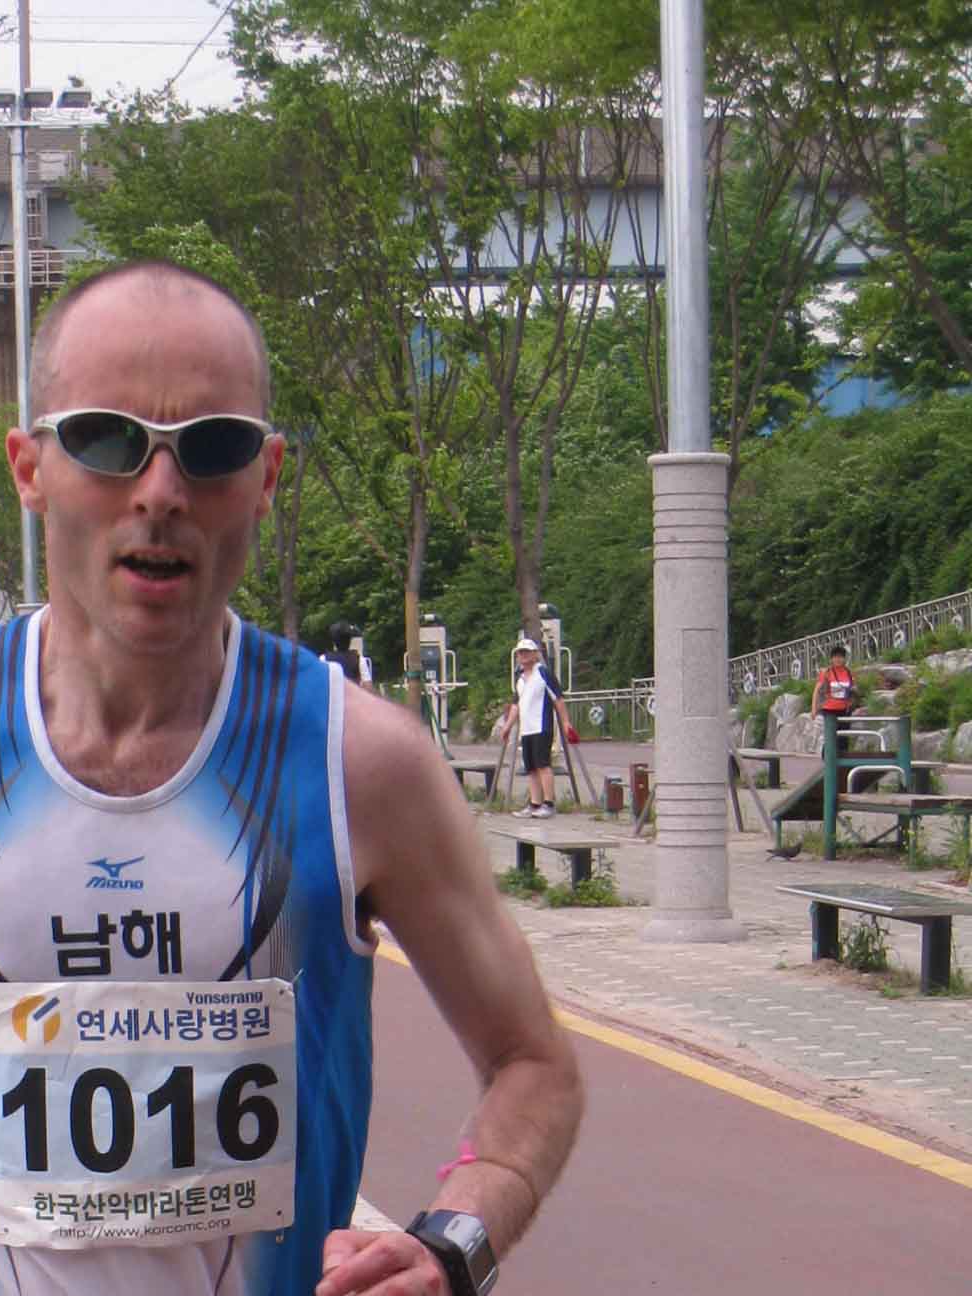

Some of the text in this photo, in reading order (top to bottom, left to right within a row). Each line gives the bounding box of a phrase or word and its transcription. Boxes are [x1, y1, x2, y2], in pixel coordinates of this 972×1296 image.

[85, 876, 144, 888] Mizuno
[51, 909, 182, 977] 남해
[186, 991, 264, 1005] Yonserang
[76, 1006, 270, 1041] 연세사랑병원
[1, 1062, 280, 1174] 1016
[33, 1179, 257, 1222] 한국산악마라톤연맹
